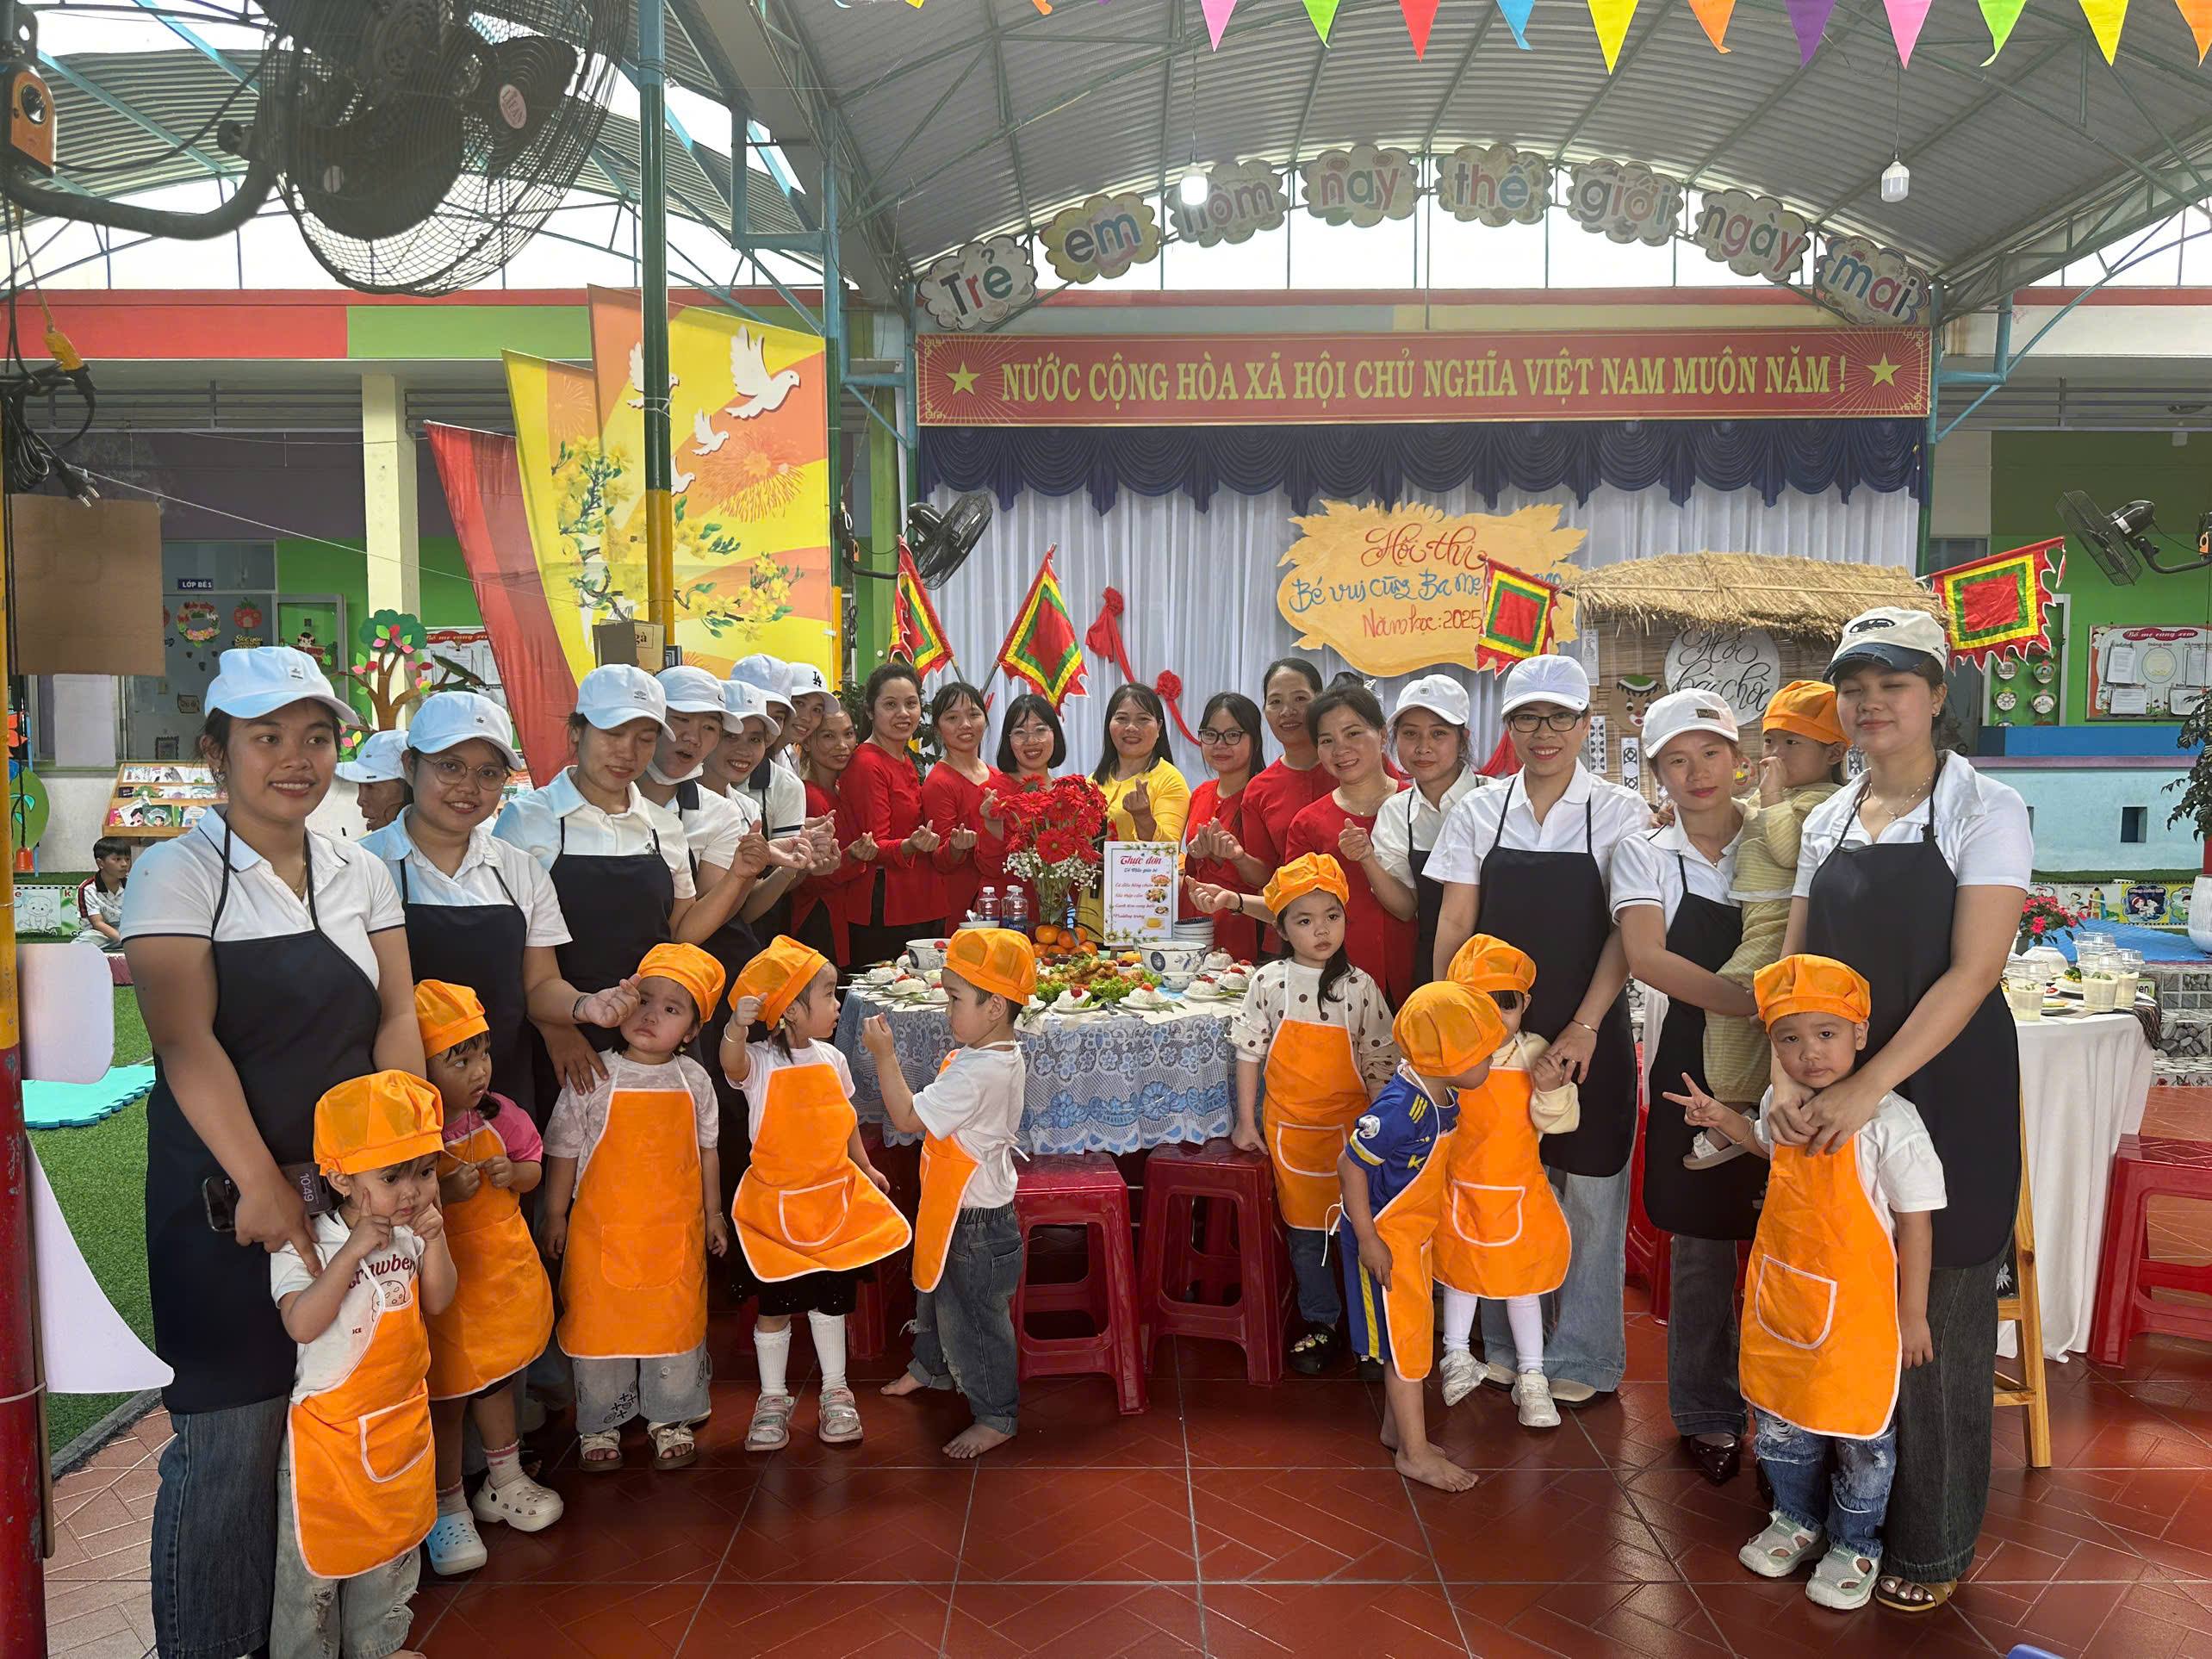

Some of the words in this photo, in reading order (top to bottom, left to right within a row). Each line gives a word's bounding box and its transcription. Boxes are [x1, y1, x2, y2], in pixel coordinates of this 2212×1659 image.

[940, 248, 1013, 316] Trẻ
[1065, 213, 1142, 263] em
[1320, 167, 1400, 211] nay
[1455, 159, 1537, 209] thế
[1580, 174, 1671, 226] giới
[1700, 204, 1804, 273] ngày
[1830, 254, 1917, 318] mai
[1002, 352, 1081, 401] NƯỚC
[1089, 352, 1169, 411] CỘNG
[1177, 351, 1239, 401] HÒA
[1244, 351, 1286, 400] XÃ
[1293, 350, 1346, 409] HỘI
[1354, 347, 1415, 399] CHỦ
[1423, 350, 1518, 398] NGHĨA
[1523, 346, 1594, 406] VIỆT
[1600, 357, 1666, 395] NAM
[1672, 345, 1758, 395] MUÔN
[1765, 345, 1831, 394] NĂM
[1839, 355, 1846, 394] !
[1361, 523, 1426, 567] Hội
[1426, 525, 1486, 570] thi
[1289, 576, 1326, 612] Bé
[1419, 567, 1452, 600] Ba
[1455, 573, 1483, 597] Mẹ
[1363, 606, 1407, 638] Năm
[1443, 609, 1482, 630] 2025
[812, 671, 822, 687] LA
[1120, 855, 1144, 866] Thực
[300, 1172, 314, 1202] 10:49
